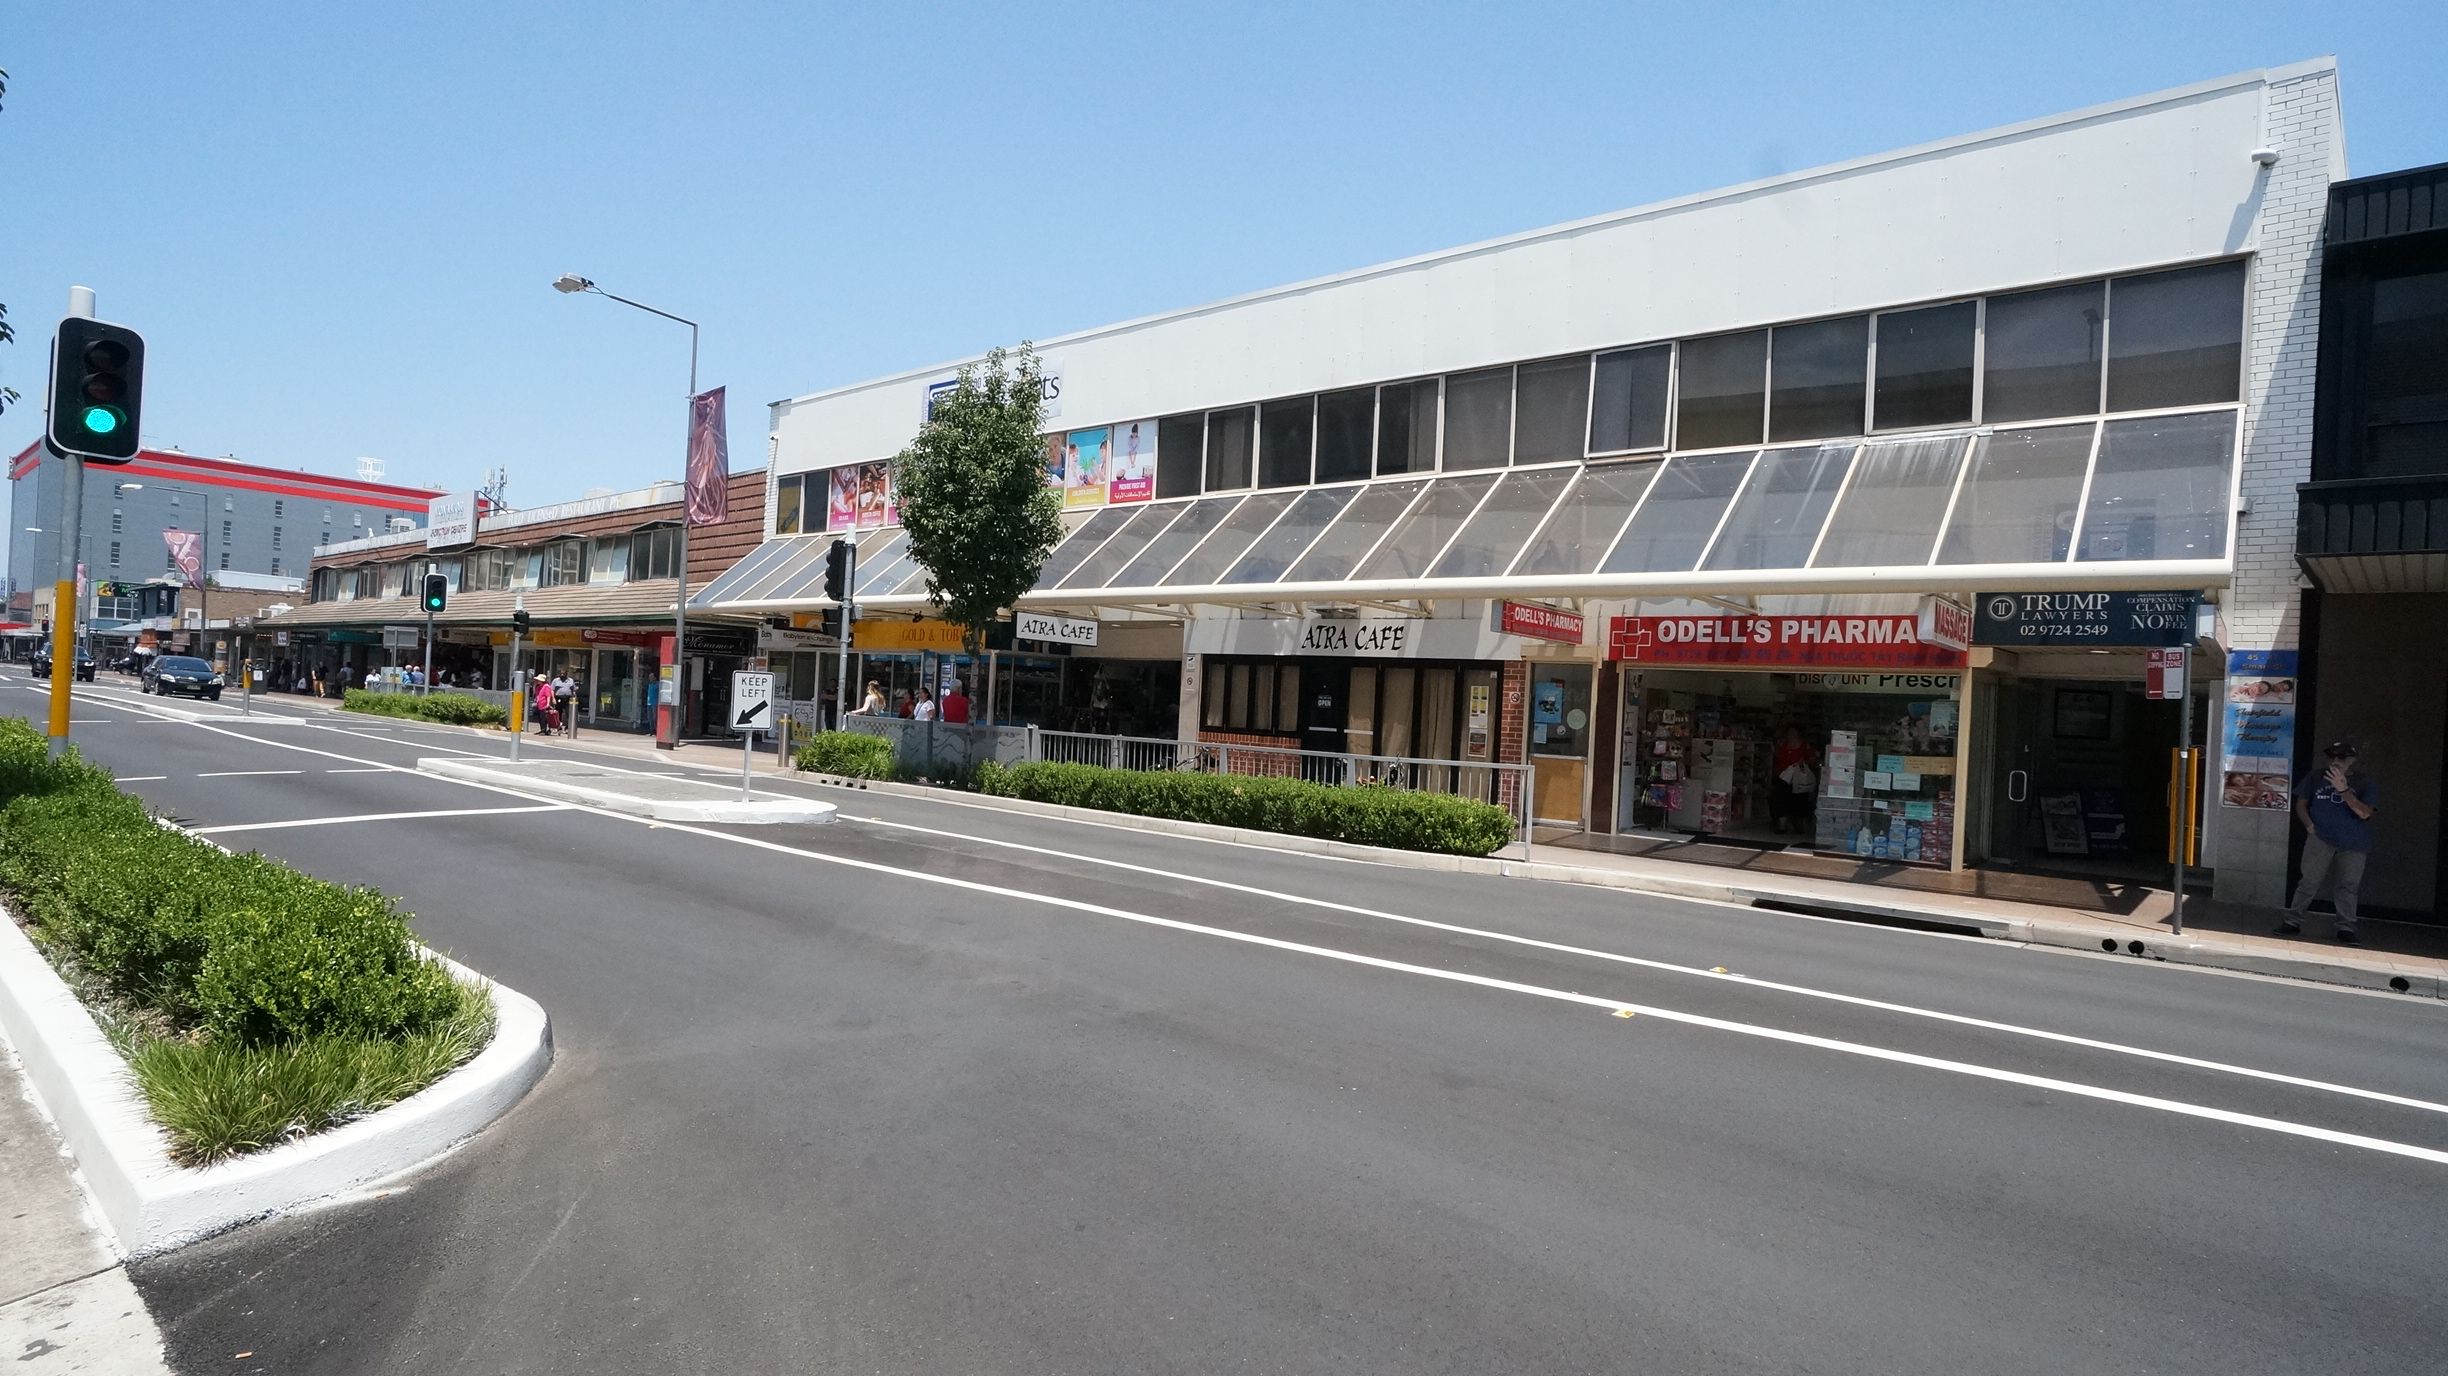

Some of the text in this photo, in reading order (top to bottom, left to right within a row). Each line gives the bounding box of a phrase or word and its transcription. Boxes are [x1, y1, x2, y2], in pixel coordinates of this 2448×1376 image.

[2021, 593, 2110, 611] TRUMP
[2126, 596, 2195, 604] COMPENSATION
[2136, 603, 2185, 612] CLAIMS
[1514, 606, 1545, 625] ODELL'S
[1546, 613, 1583, 633] PHARMACY
[2021, 611, 2108, 620] LAWYERS
[2130, 614, 2164, 630] NO
[2164, 614, 2187, 622] WIN
[1020, 619, 1094, 640] ATRA CAFE
[1935, 602, 1967, 644] MASSAGE
[2020, 624, 2109, 636] 02 9724 2549
[902, 628, 925, 642] GOLD
[1301, 625, 1405, 652] ATRA CAFE
[1657, 619, 1917, 644] ODELL'S PHARMA
[741, 676, 768, 687] KEEP
[741, 688, 766, 698] LEFT
